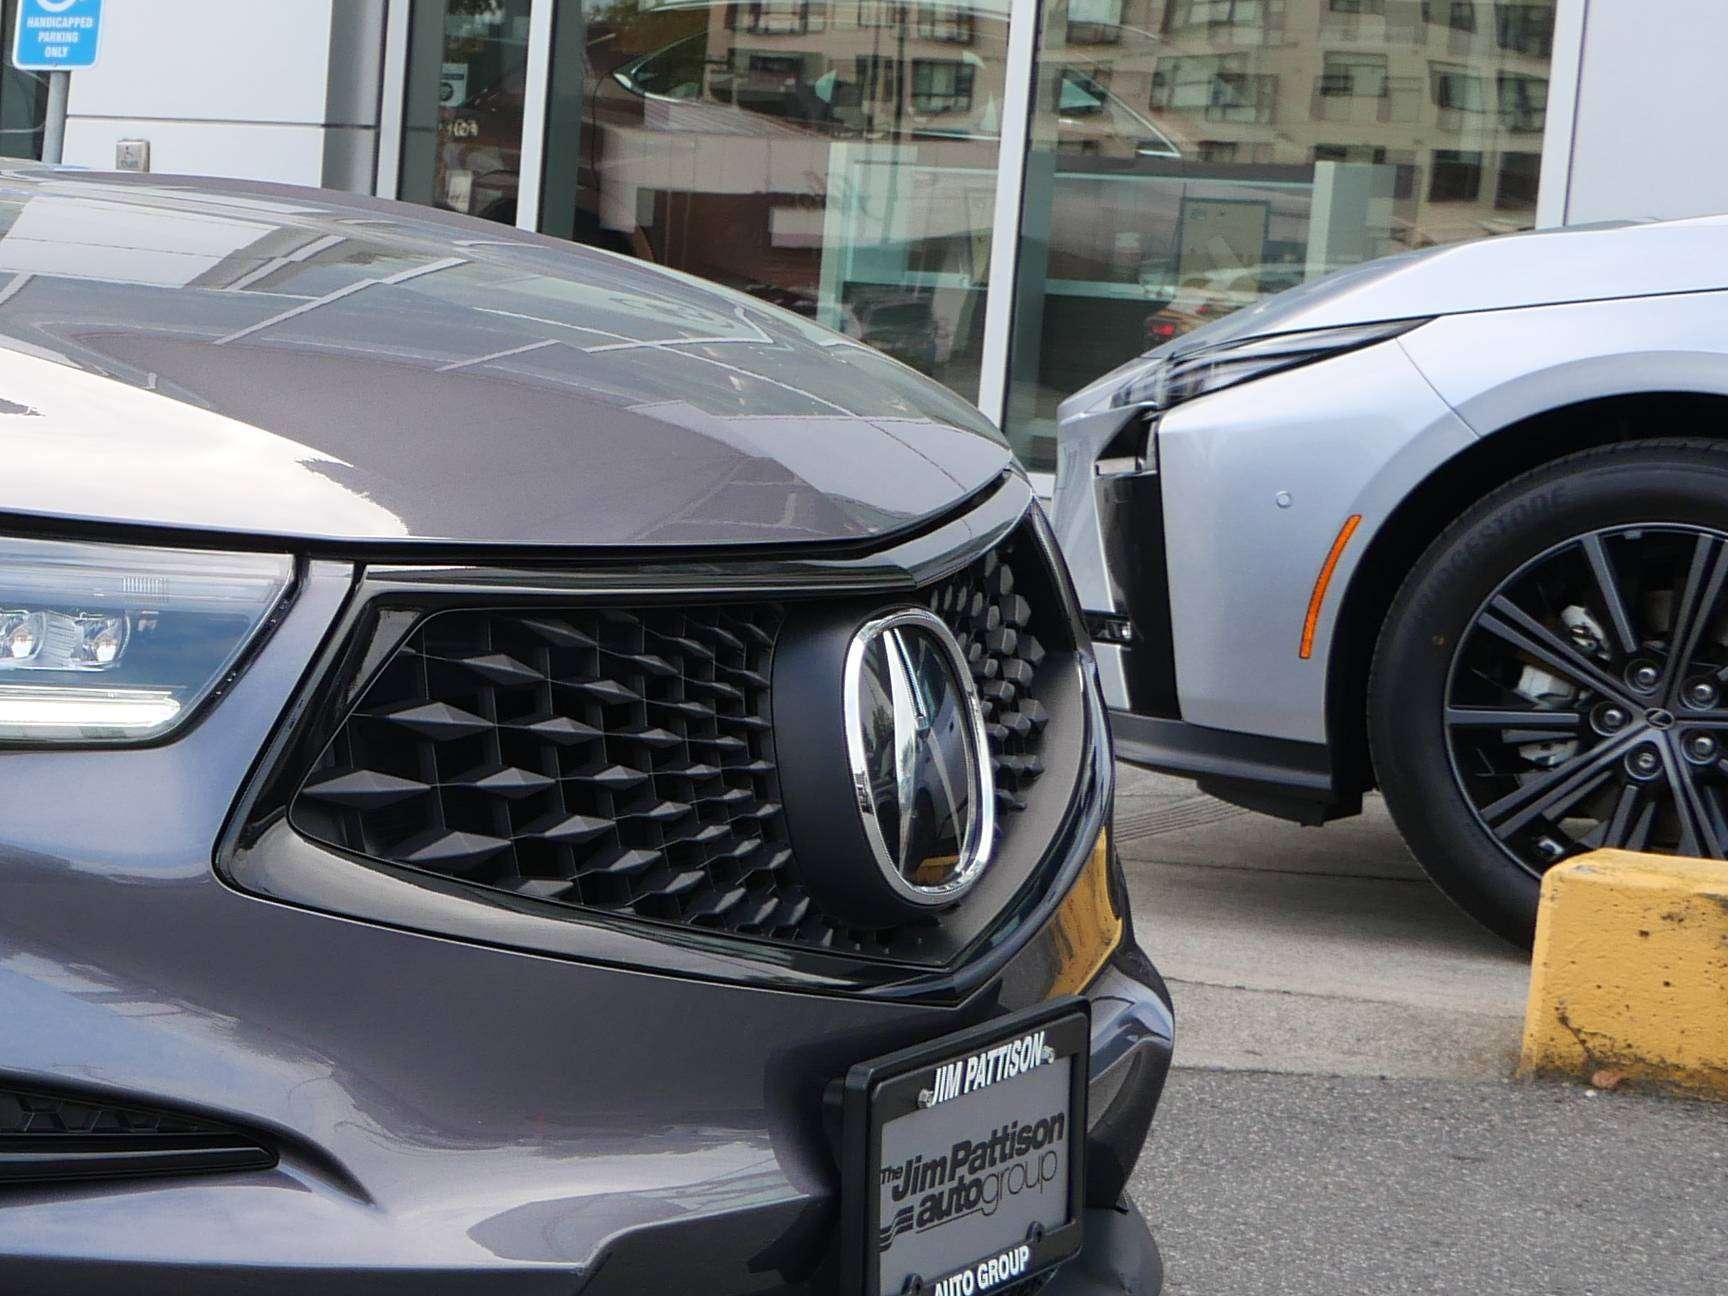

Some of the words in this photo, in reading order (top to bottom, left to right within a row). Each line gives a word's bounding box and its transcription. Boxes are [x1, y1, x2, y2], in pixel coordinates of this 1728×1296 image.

[26, 16, 94, 29] HANDICAPPED
[38, 31, 79, 43] PARKING
[44, 46, 69, 58] ONLY
[930, 1061, 961, 1107] JIM
[964, 1031, 1046, 1094] PATTISON
[977, 1245, 1030, 1289] GROUP
